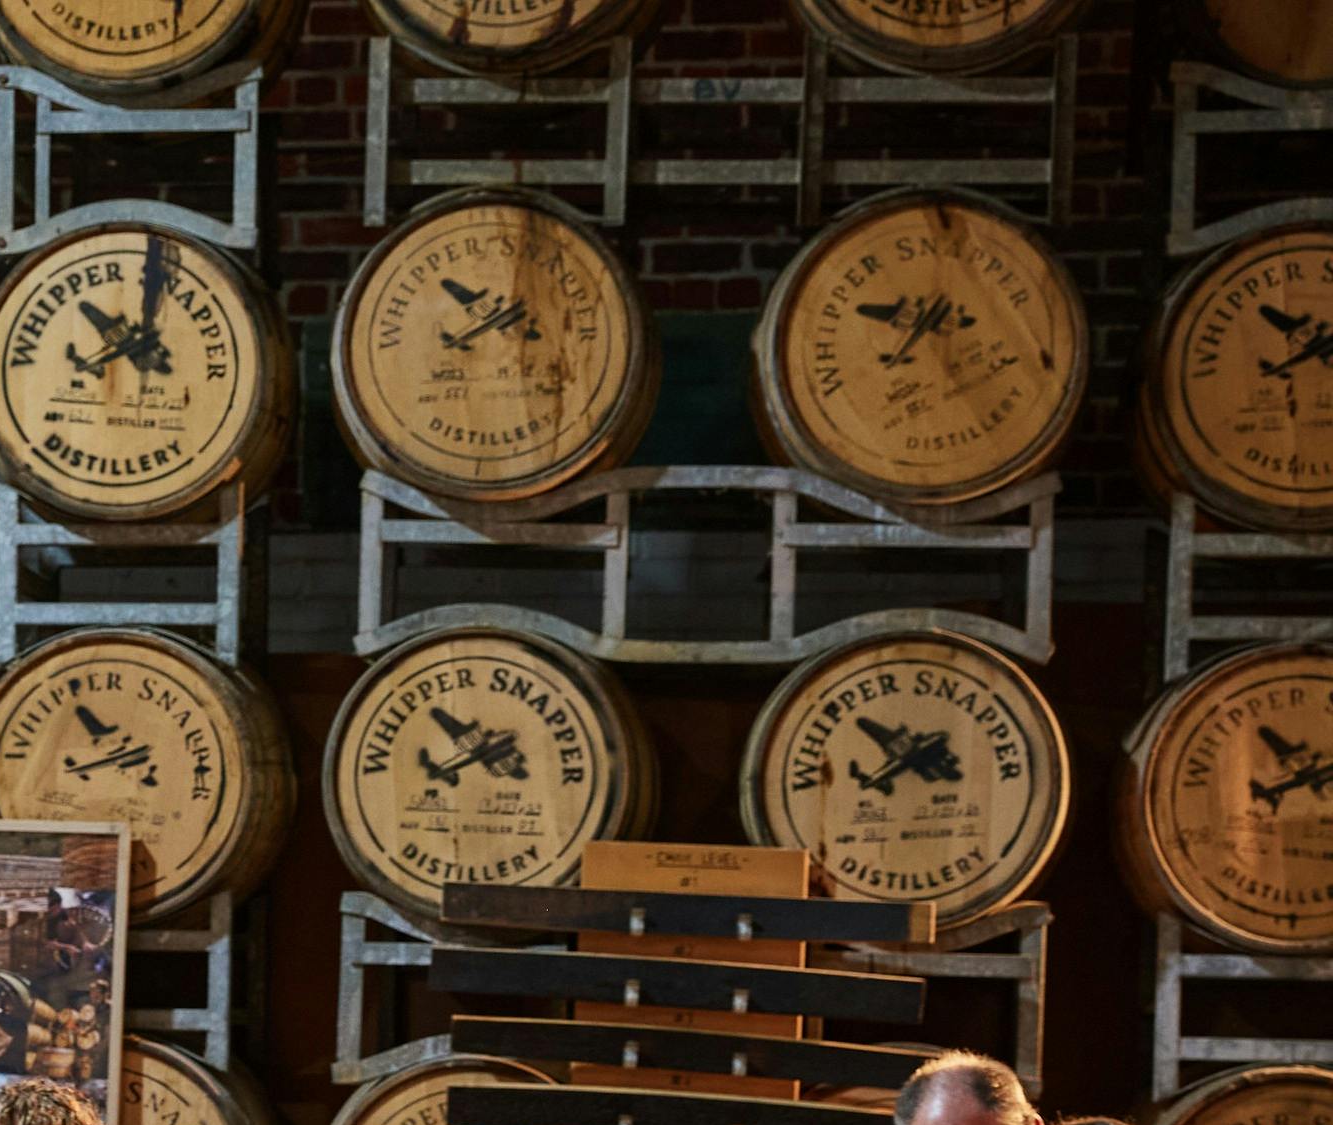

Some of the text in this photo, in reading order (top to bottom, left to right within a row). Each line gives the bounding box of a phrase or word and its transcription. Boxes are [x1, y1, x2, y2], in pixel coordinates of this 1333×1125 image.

[51, 5, 171, 41] DISTILLERY
[11, 262, 124, 368] WHIPPER
[380, 238, 483, 350] WHIPPER
[815, 254, 882, 397] WHIPPER
[1194, 262, 1304, 380] WHIPPER
[44, 434, 182, 476] DISTILLERY
[906, 385, 1022, 451] DISTILLERY
[363, 668, 584, 786] WHIPPER SNAPPER
[792, 672, 1021, 791] WHIPPER SNAPPER
[1184, 689, 1305, 789] WHIPPER
[401, 842, 540, 882] DISTILLERY
[842, 847, 985, 891] DISTILLERY
